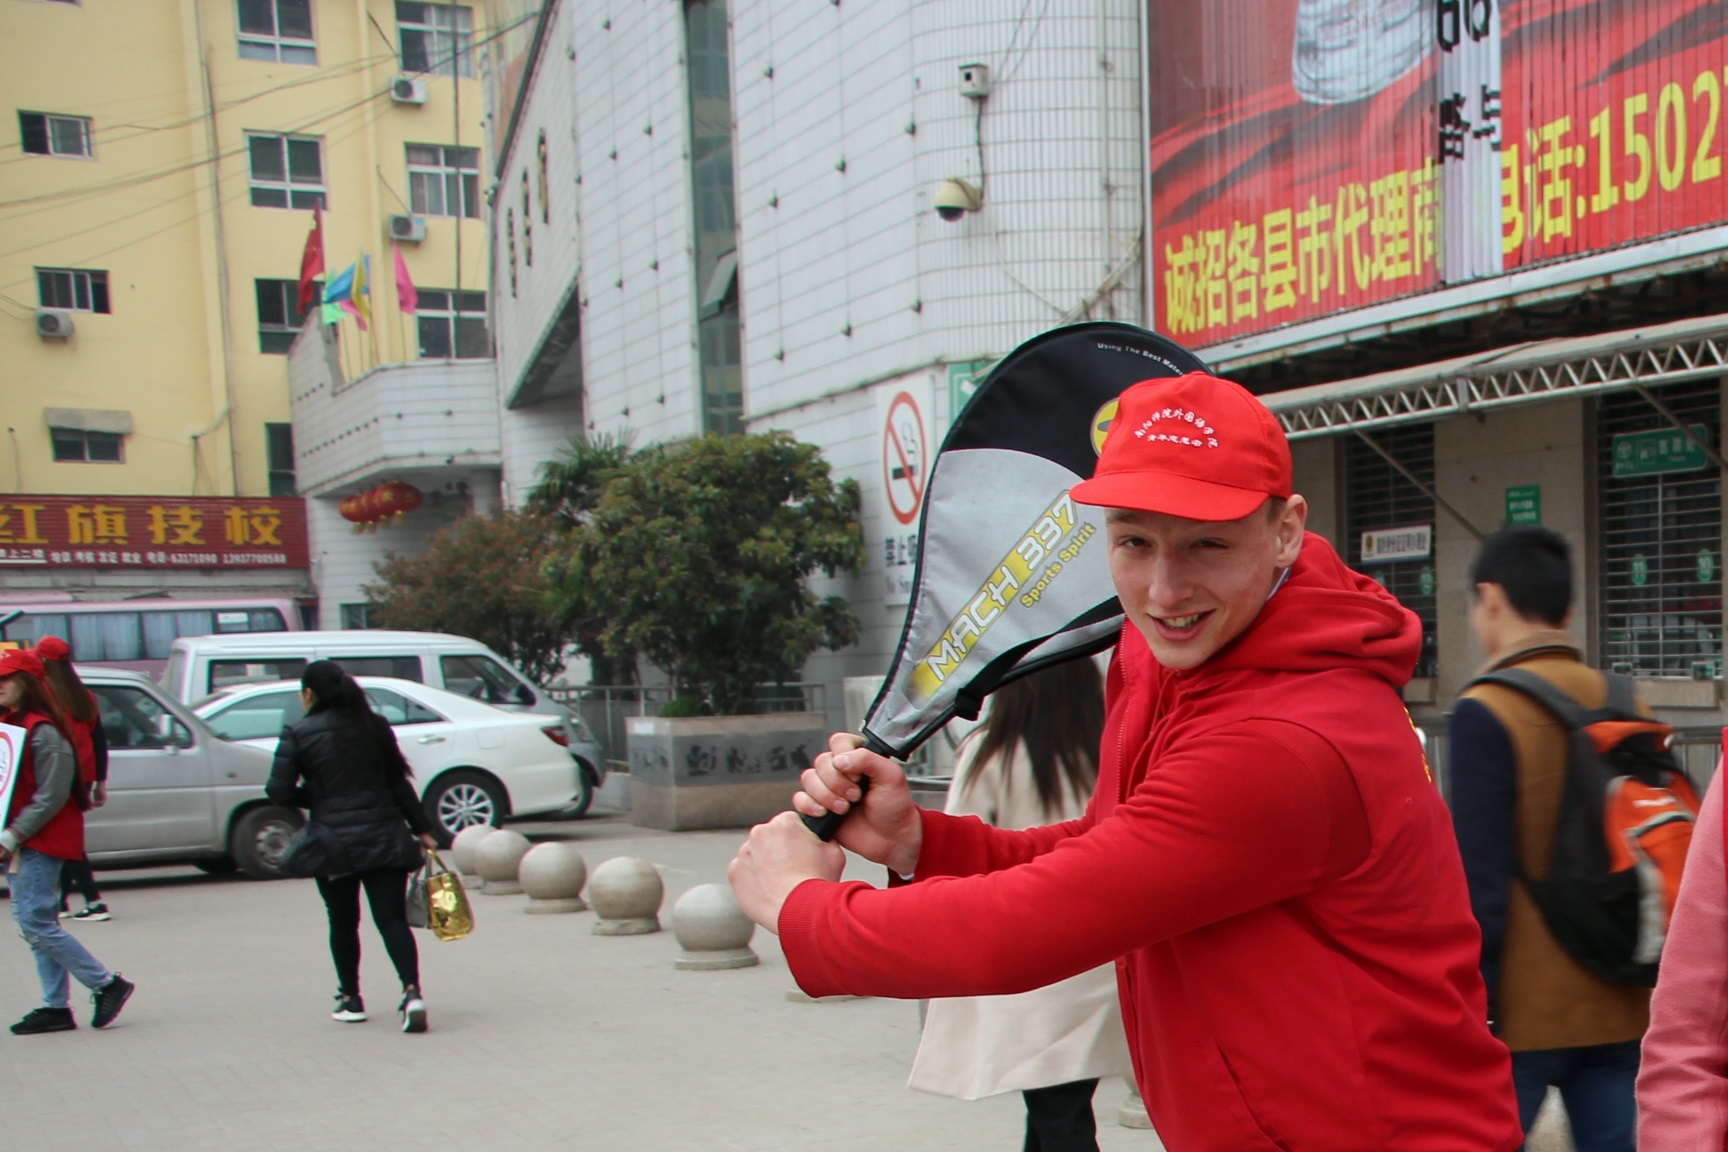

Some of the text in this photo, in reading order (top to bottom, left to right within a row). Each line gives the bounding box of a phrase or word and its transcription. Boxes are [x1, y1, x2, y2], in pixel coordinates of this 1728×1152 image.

[1164, 156, 1443, 336] 诚招各县市代理商
[1097, 342, 1122, 352] Using
[1125, 345, 1140, 354] The
[1142, 350, 1162, 362] Best
[0, 503, 284, 546] 红旗技校
[1021, 521, 1097, 608] Sports Spirit
[927, 494, 1076, 682] MACH 337
